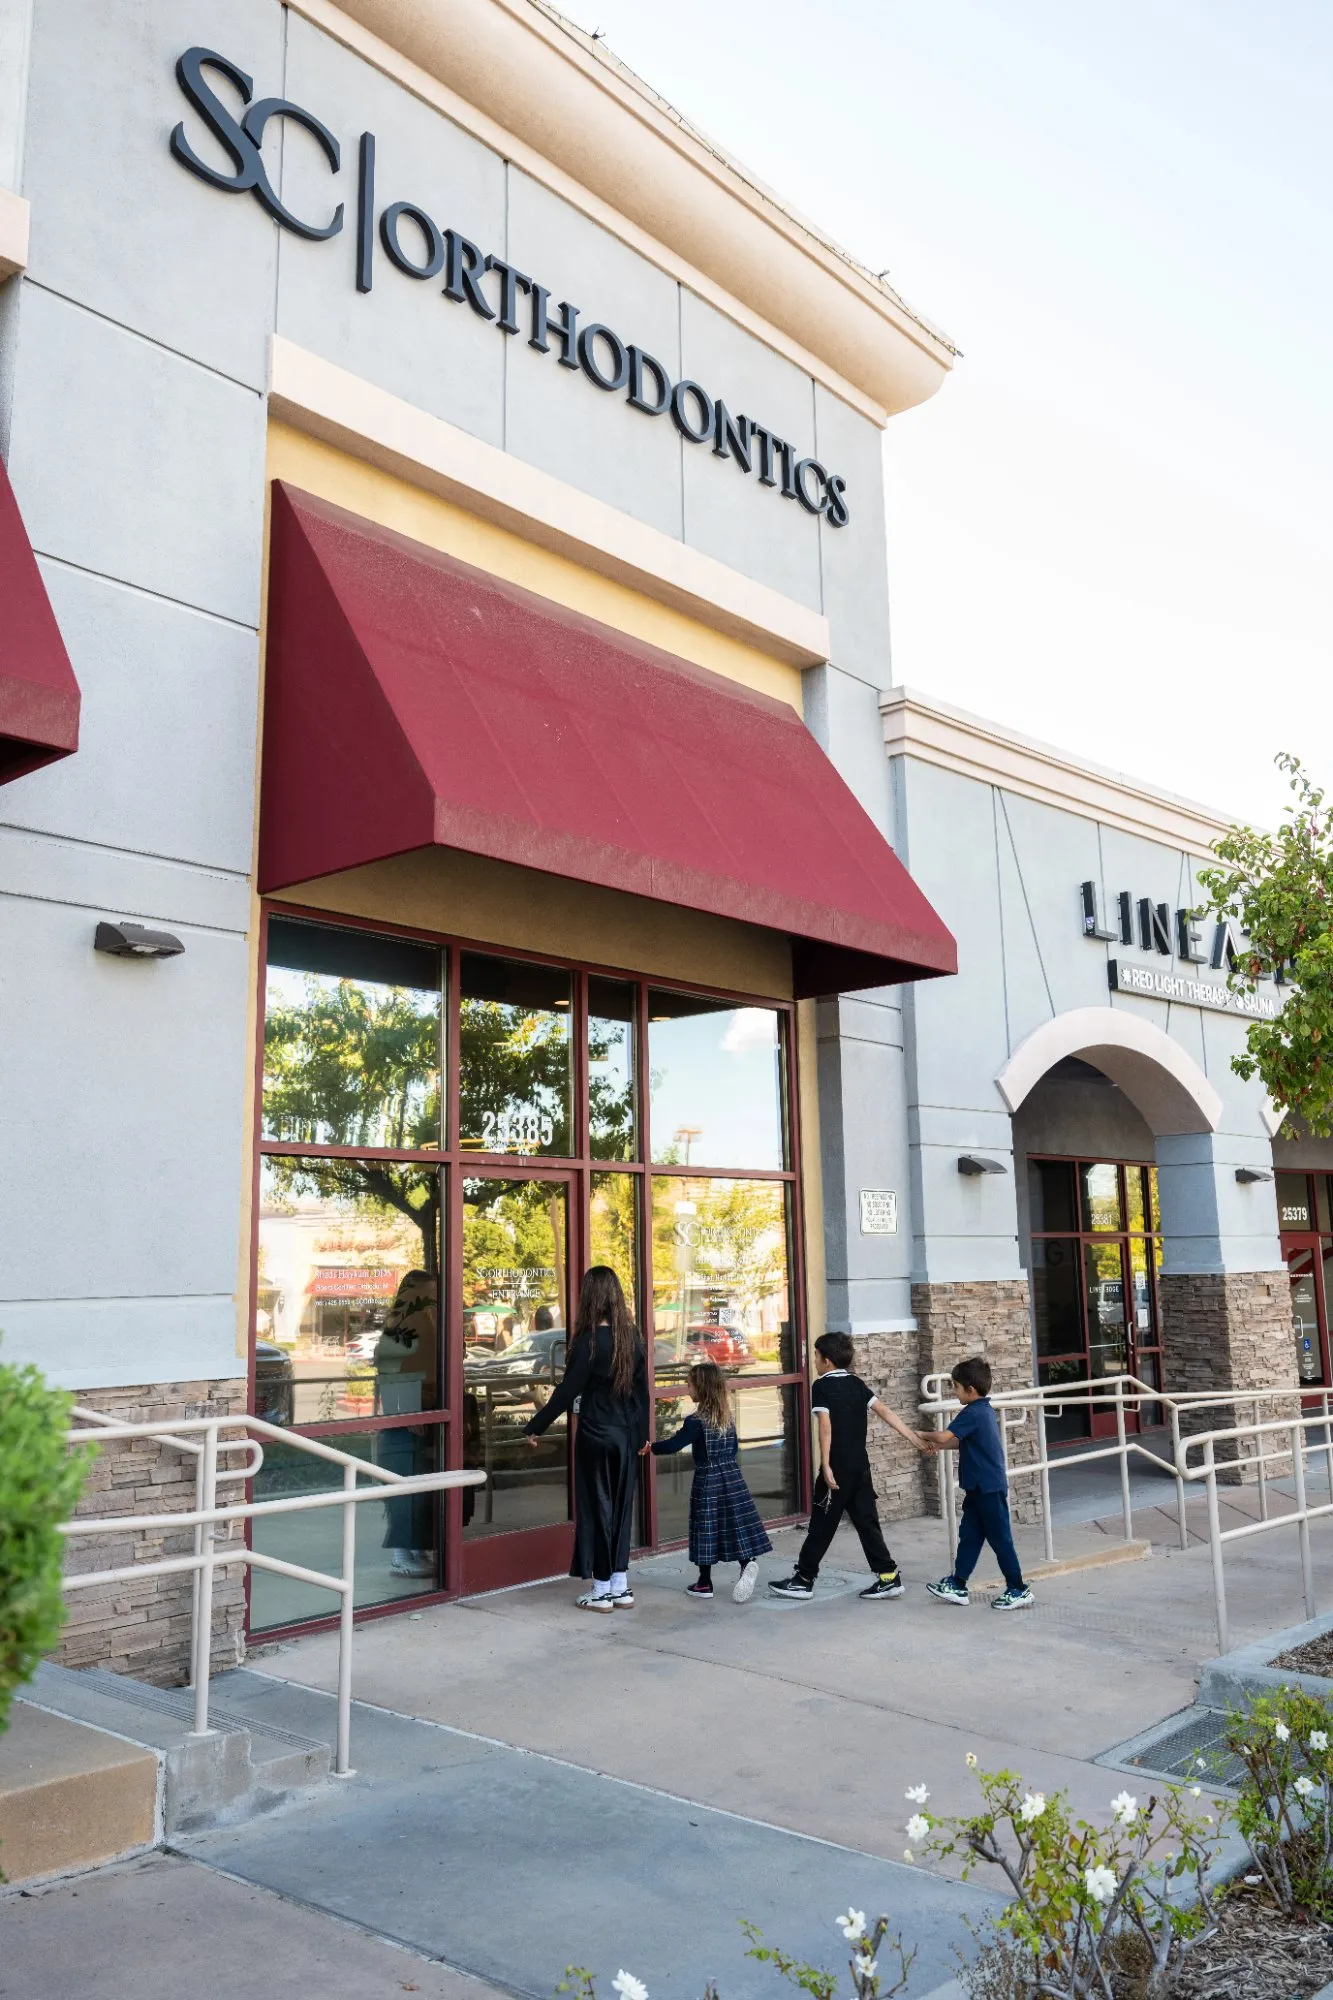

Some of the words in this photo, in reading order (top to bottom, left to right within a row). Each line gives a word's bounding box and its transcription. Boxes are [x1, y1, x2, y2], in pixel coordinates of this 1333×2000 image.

[379, 201, 850, 528] ORTHODONTICS
[1132, 968, 1153, 990] RED
[1154, 973, 1185, 998] LIGHT
[1185, 980, 1232, 1006] THERAPY
[1244, 993, 1276, 1016] SAUNA
[481, 1110, 554, 1146] 25385
[1282, 1206, 1308, 1222] 25379
[492, 1288, 541, 1299] ENTRANCE
